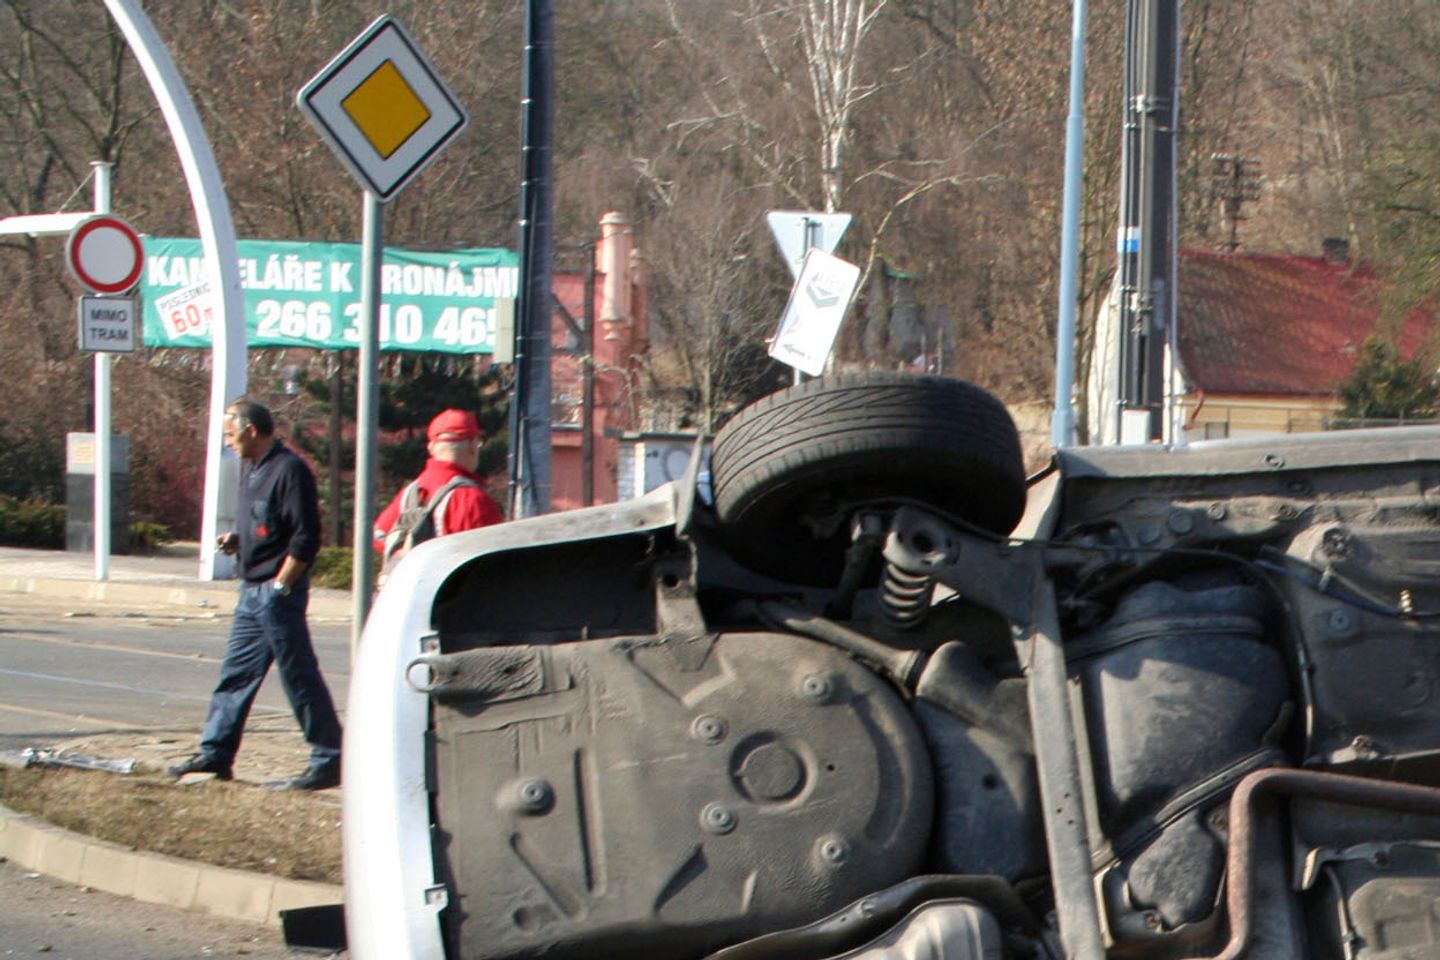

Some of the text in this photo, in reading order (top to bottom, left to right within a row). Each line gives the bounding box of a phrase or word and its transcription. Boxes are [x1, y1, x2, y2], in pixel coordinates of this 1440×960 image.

[330, 262, 353, 292] K
[381, 261, 518, 298] RONÁJM
[91, 309, 128, 322] MIMO
[171, 304, 200, 333] 60
[256, 299, 332, 341] 266
[343, 301, 423, 344] 310
[89, 327, 129, 340] TRAM
